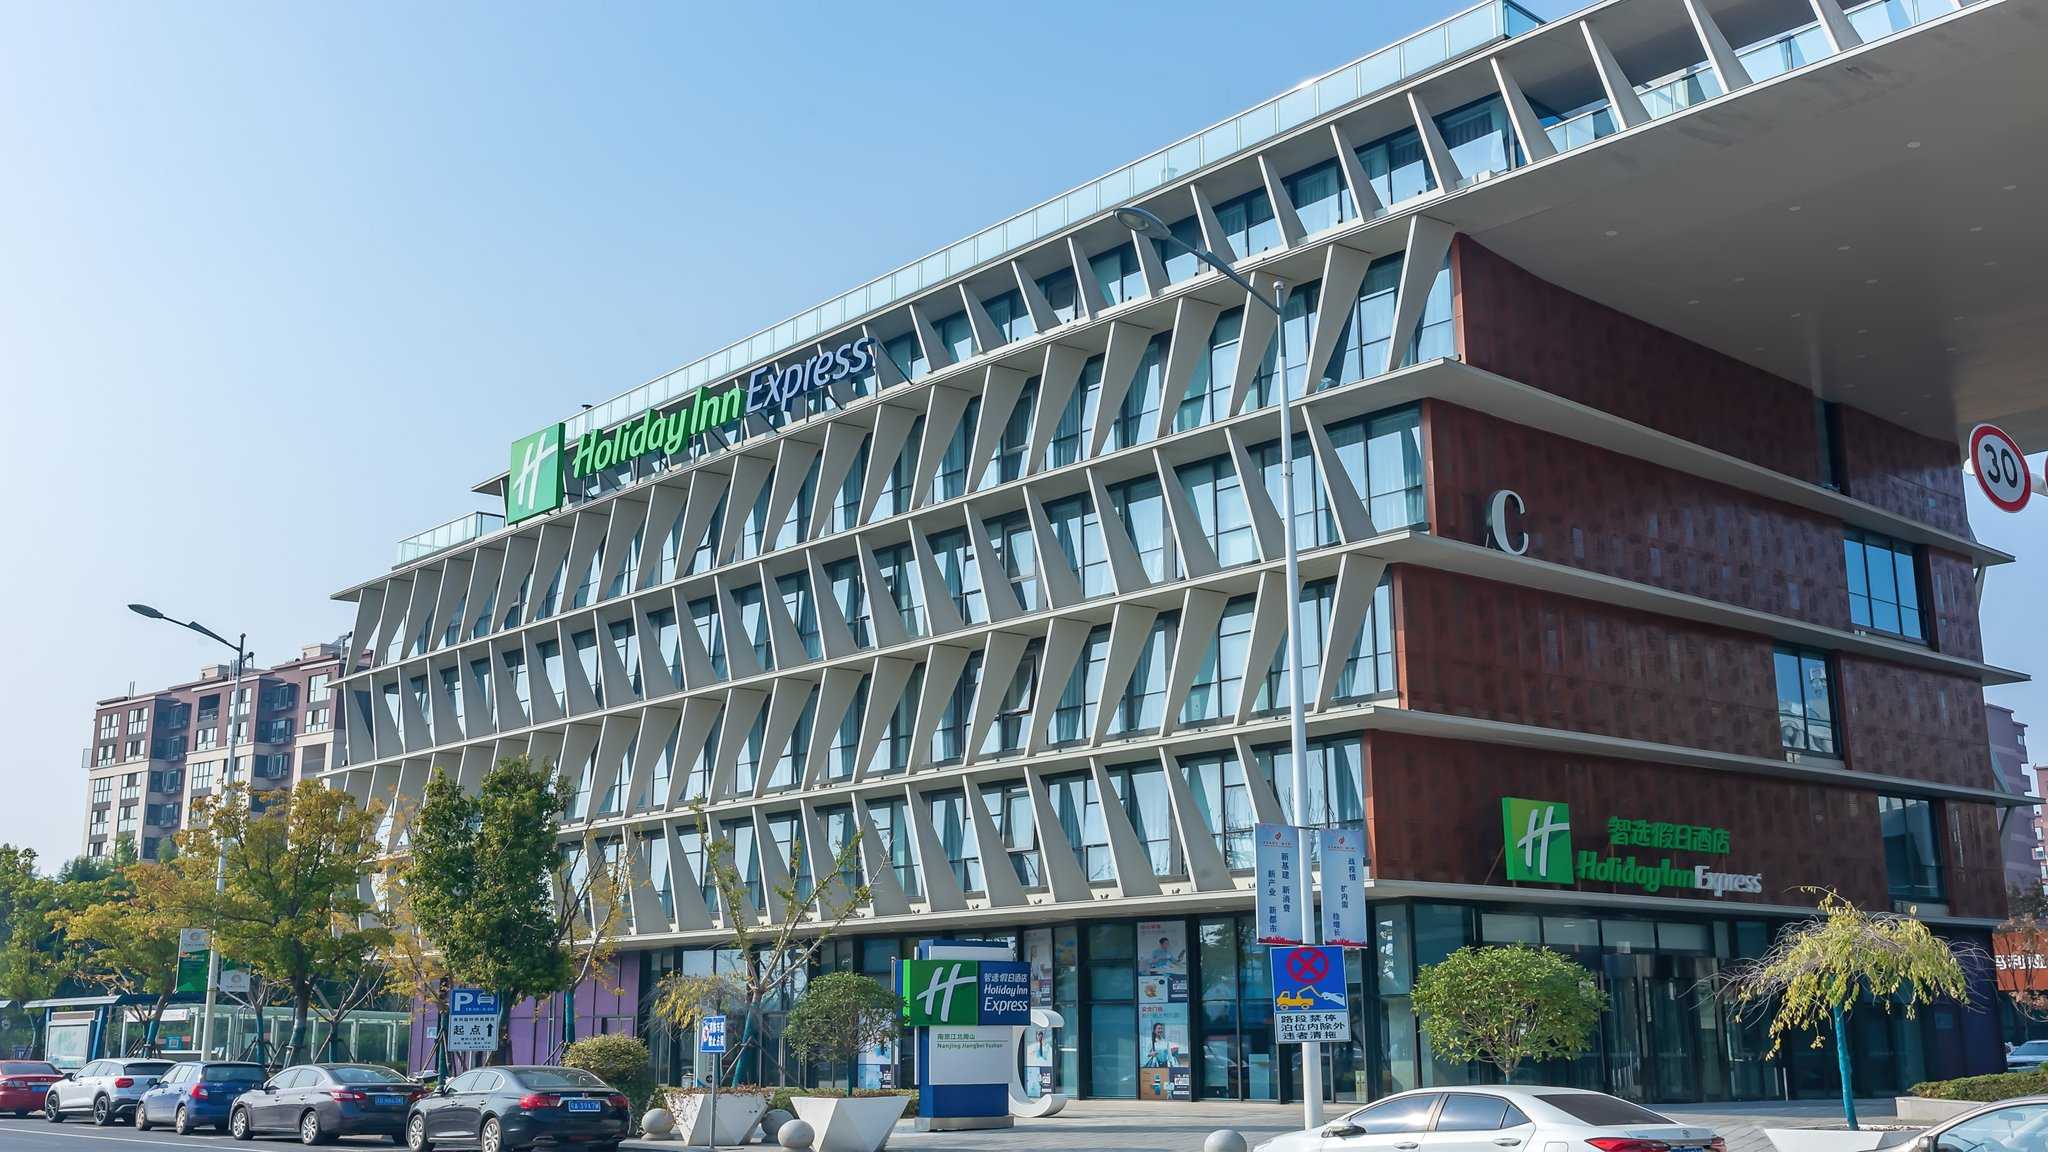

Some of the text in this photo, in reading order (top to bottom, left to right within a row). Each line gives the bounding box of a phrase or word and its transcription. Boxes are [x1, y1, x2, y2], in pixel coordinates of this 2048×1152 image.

[572, 336, 875, 479] Holiday Inn Express
[1984, 444, 2017, 488] 30
[1490, 489, 1529, 555] C
[1608, 816, 1731, 854] 智选假日酒店
[1281, 852, 1290, 913] 新基建 新消费
[1577, 850, 1762, 897] Holiday Inn Express
[1268, 869, 1277, 933] 新产业 新都市
[984, 972, 1028, 983] 智选假日酒店
[984, 984, 1015, 997] Holiday
[1015, 985, 1028, 995] Inn
[454, 992, 474, 1011] P
[984, 997, 1028, 1015] Express
[1281, 1014, 1336, 1023] 路段禁停
[1281, 1022, 1345, 1032] 泊位内除外
[454, 1025, 481, 1036] 起点
[1284, 1031, 1337, 1040] 违者清拖
